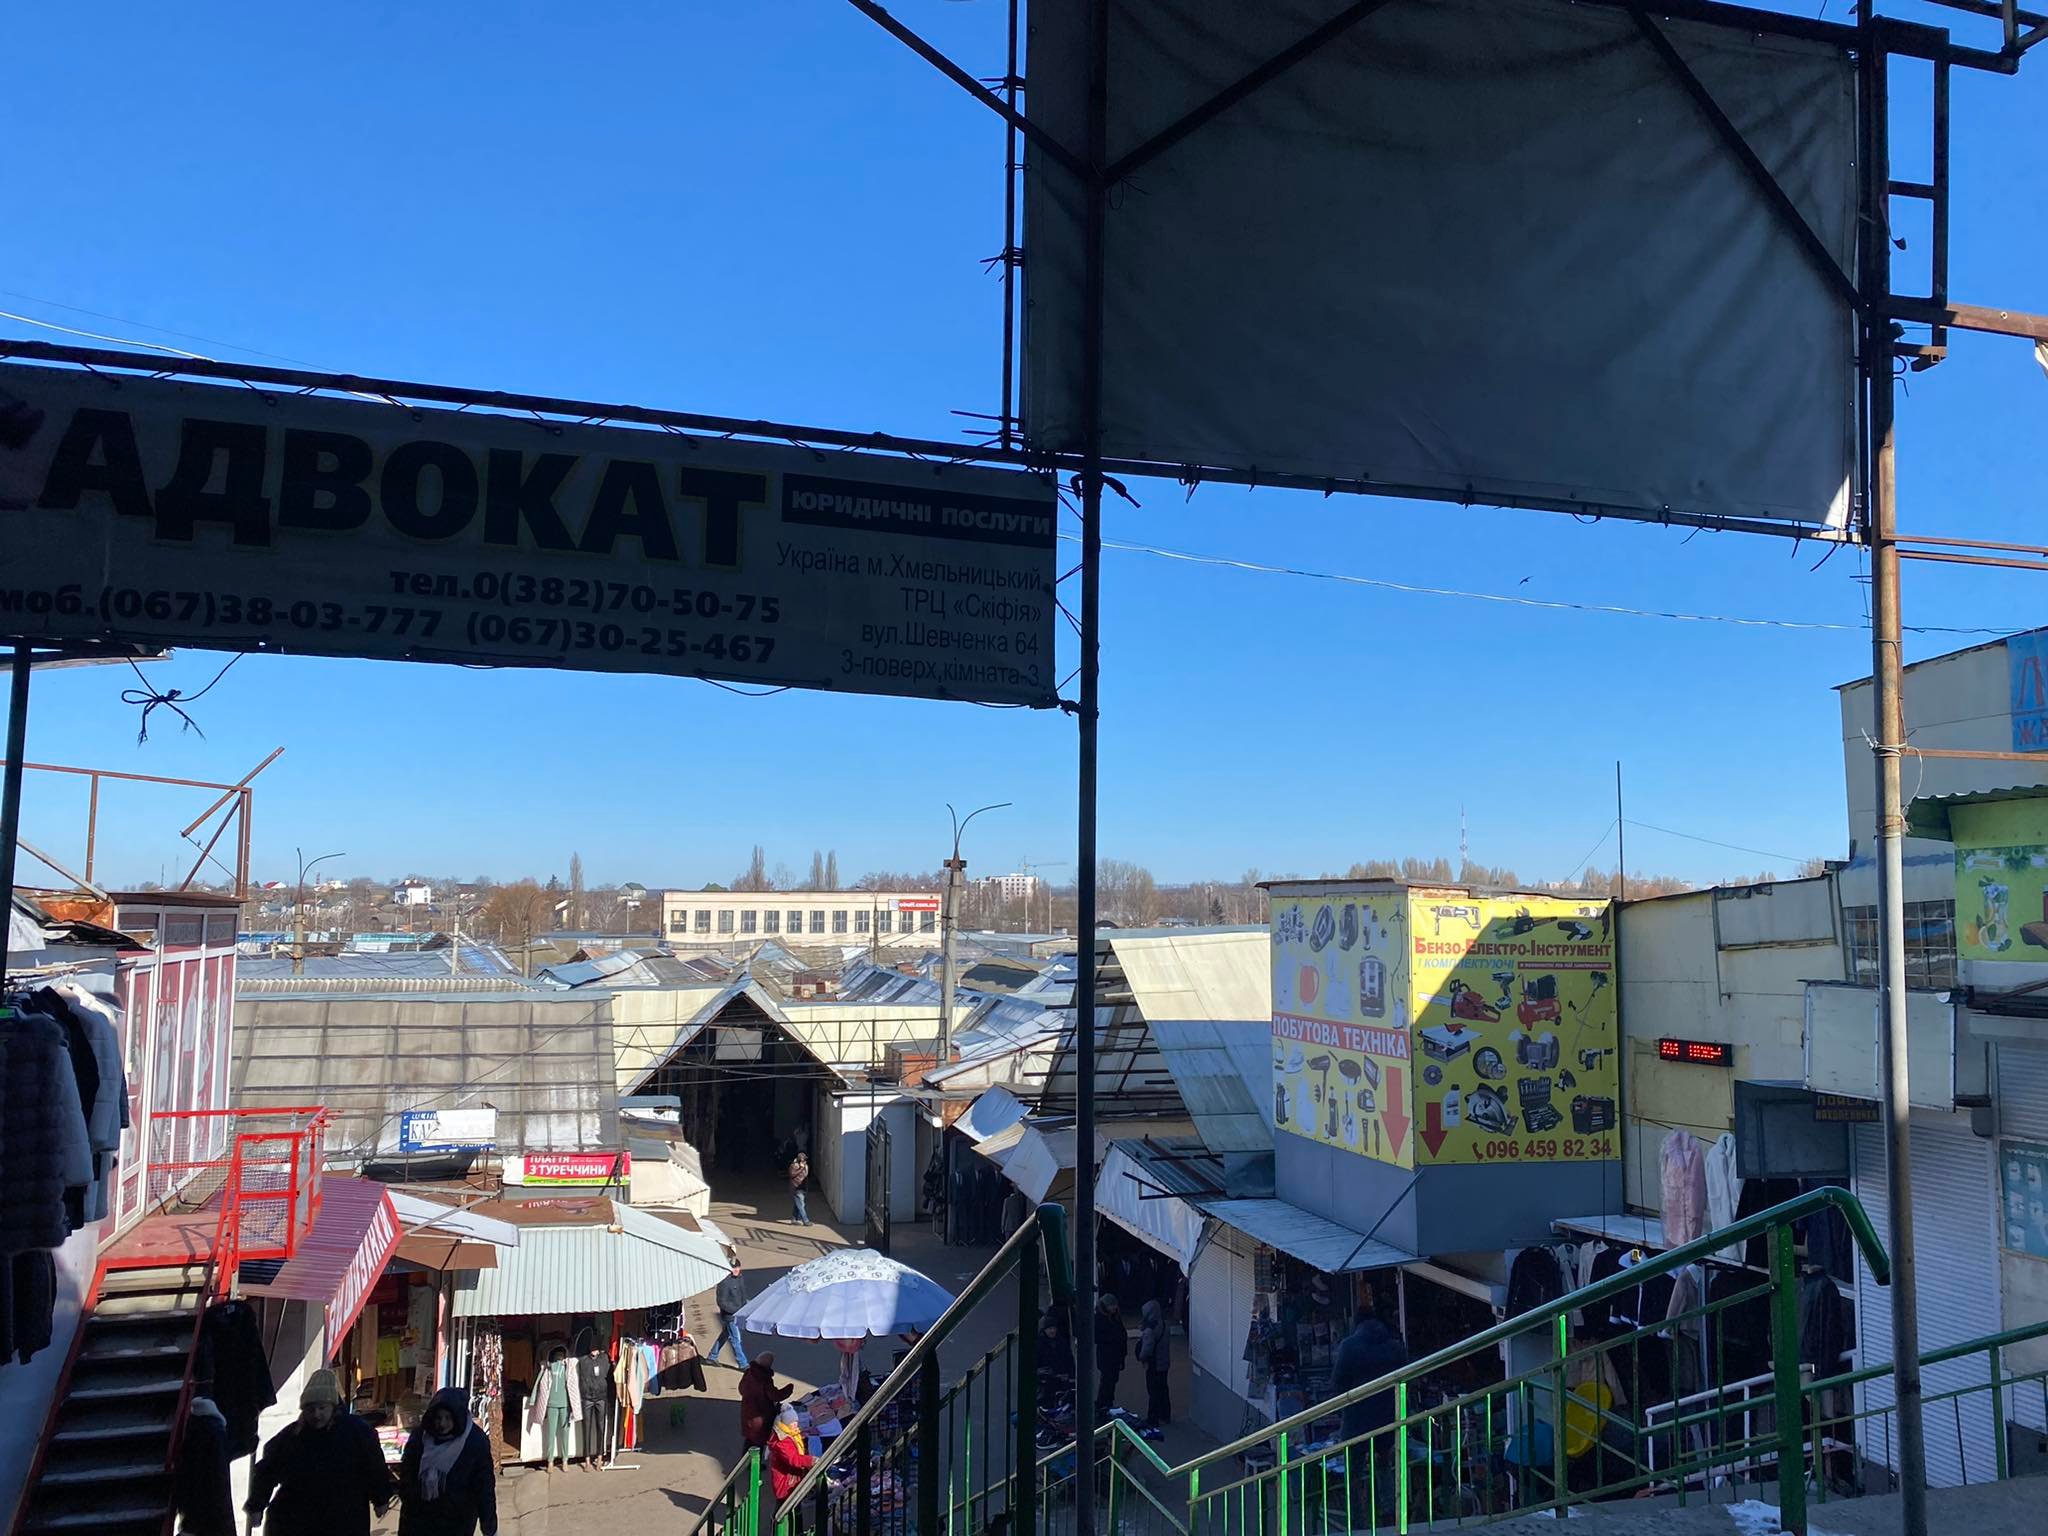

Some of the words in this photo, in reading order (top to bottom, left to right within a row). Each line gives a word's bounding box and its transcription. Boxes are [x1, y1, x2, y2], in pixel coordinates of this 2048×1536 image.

[38, 407, 768, 567] АДВОКАТ
[791, 490, 932, 523] ЮРИДИЧНІ
[941, 506, 1050, 536] ПОСЛУГИ
[775, 541, 860, 576] Україна
[866, 553, 1042, 591] м.Хмельницький
[390, 570, 781, 624] тел.0(382)70-50-75
[900, 587, 946, 620] ТРЦ
[466, 610, 776, 664] (067)30-25-467
[862, 621, 1009, 652] вул.Шевченка
[1015, 631, 1040, 656] 64
[1423, 958, 1515, 970] КОМПЛЕКТУЮЧІ
[1272, 1015, 1340, 1047] ПОБУТОВА
[1343, 1026, 1409, 1059] ТЕХНІКА
[539, 1164, 607, 1175] ТУРЕЧЧИНИ
[1486, 1140, 1519, 1158] 096
[1524, 1140, 1557, 1157] 459
[1563, 1139, 1585, 1156] 82
[1590, 1138, 1612, 1156] 34
